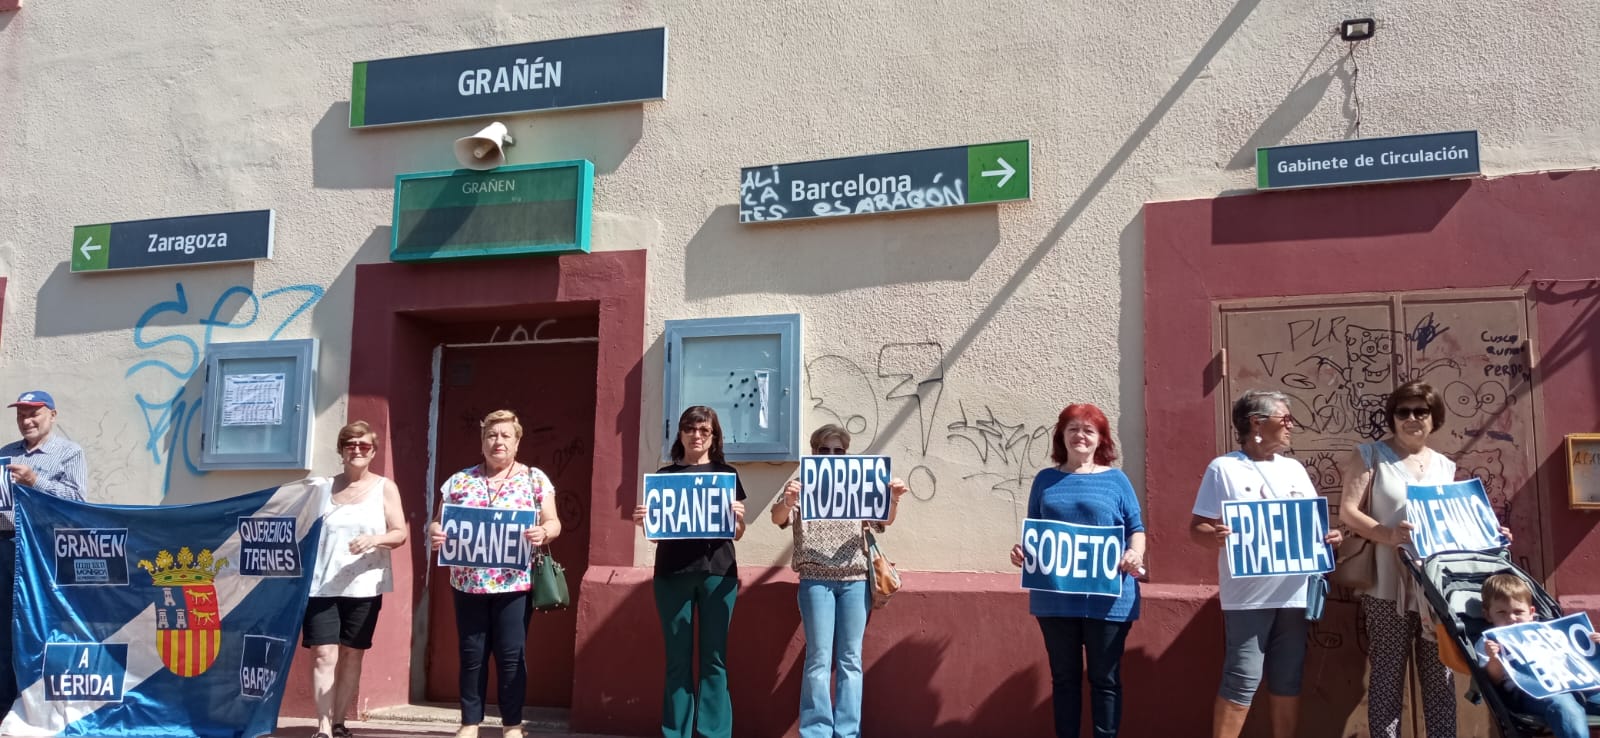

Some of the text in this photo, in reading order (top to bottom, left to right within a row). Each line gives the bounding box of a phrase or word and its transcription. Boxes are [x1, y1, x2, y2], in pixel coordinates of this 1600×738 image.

[458, 56, 562, 96] GRAÑÉN
[1277, 145, 1469, 174] Gabinete de Circulación
[462, 178, 516, 194] GRAÑEN
[791, 173, 912, 202] Barcelona
[855, 172, 965, 214] ARAGÓN
[147, 232, 228, 254] Zaragoza
[803, 457, 887, 519] ROBRES
[646, 475, 735, 533] GRAÑÉN
[56, 529, 125, 558] GRAÑEN
[241, 521, 292, 544] QUEREMOS
[442, 511, 533, 566] GRAÑÉN
[1225, 501, 1332, 575] FRAELLA
[244, 548, 295, 570] TRENES
[1024, 528, 1121, 580] SODETO
[78, 647, 89, 668] A
[50, 669, 114, 696] LÉRIDA
